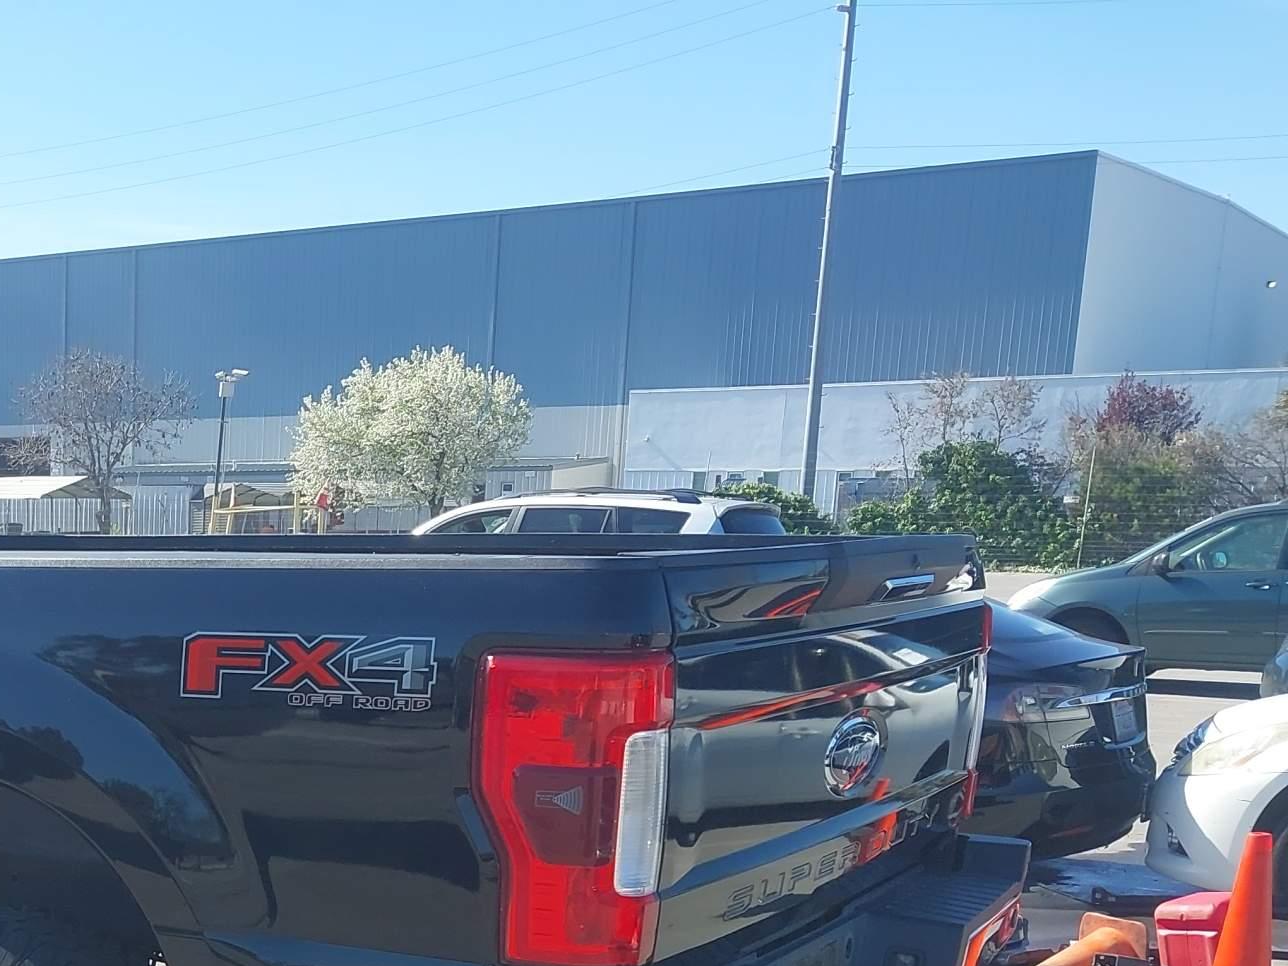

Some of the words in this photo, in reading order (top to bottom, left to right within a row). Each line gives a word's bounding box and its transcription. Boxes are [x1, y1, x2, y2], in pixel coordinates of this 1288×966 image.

[180, 631, 437, 699] FX4
[287, 692, 343, 707] OFF
[352, 695, 431, 712] ROAD
[722, 840, 862, 922] SUPER
